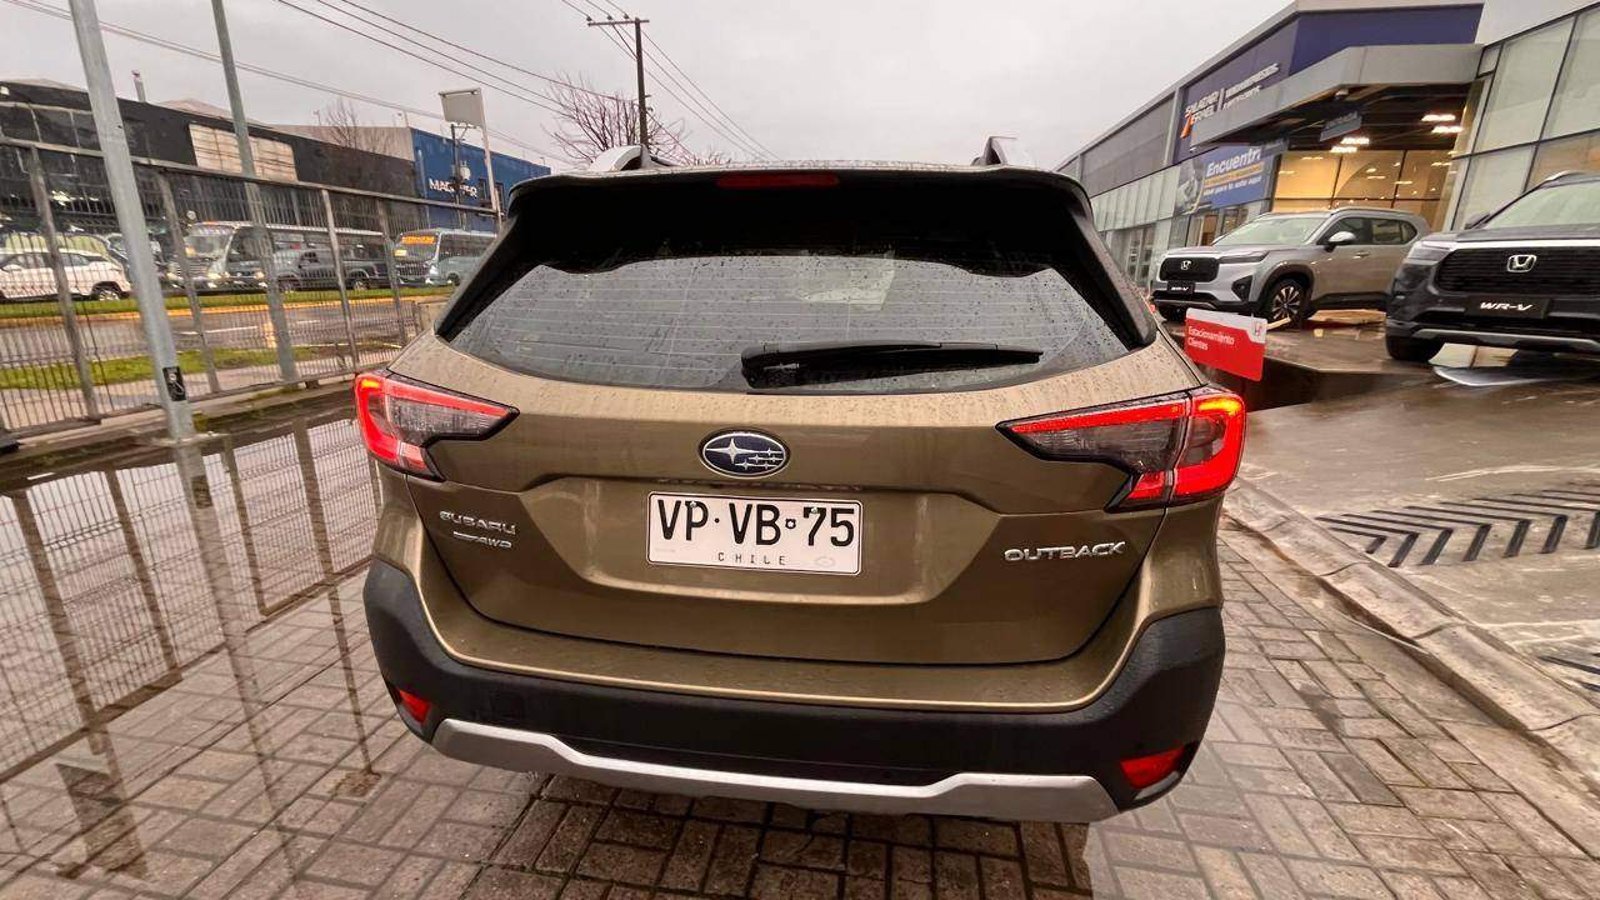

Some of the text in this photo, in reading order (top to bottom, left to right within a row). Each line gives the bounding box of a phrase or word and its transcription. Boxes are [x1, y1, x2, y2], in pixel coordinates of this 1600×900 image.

[1479, 301, 1534, 312] WR-V
[439, 510, 516, 535] SUBARU
[717, 551, 787, 566] CHILE
[1004, 540, 1127, 561] OUTBACK
